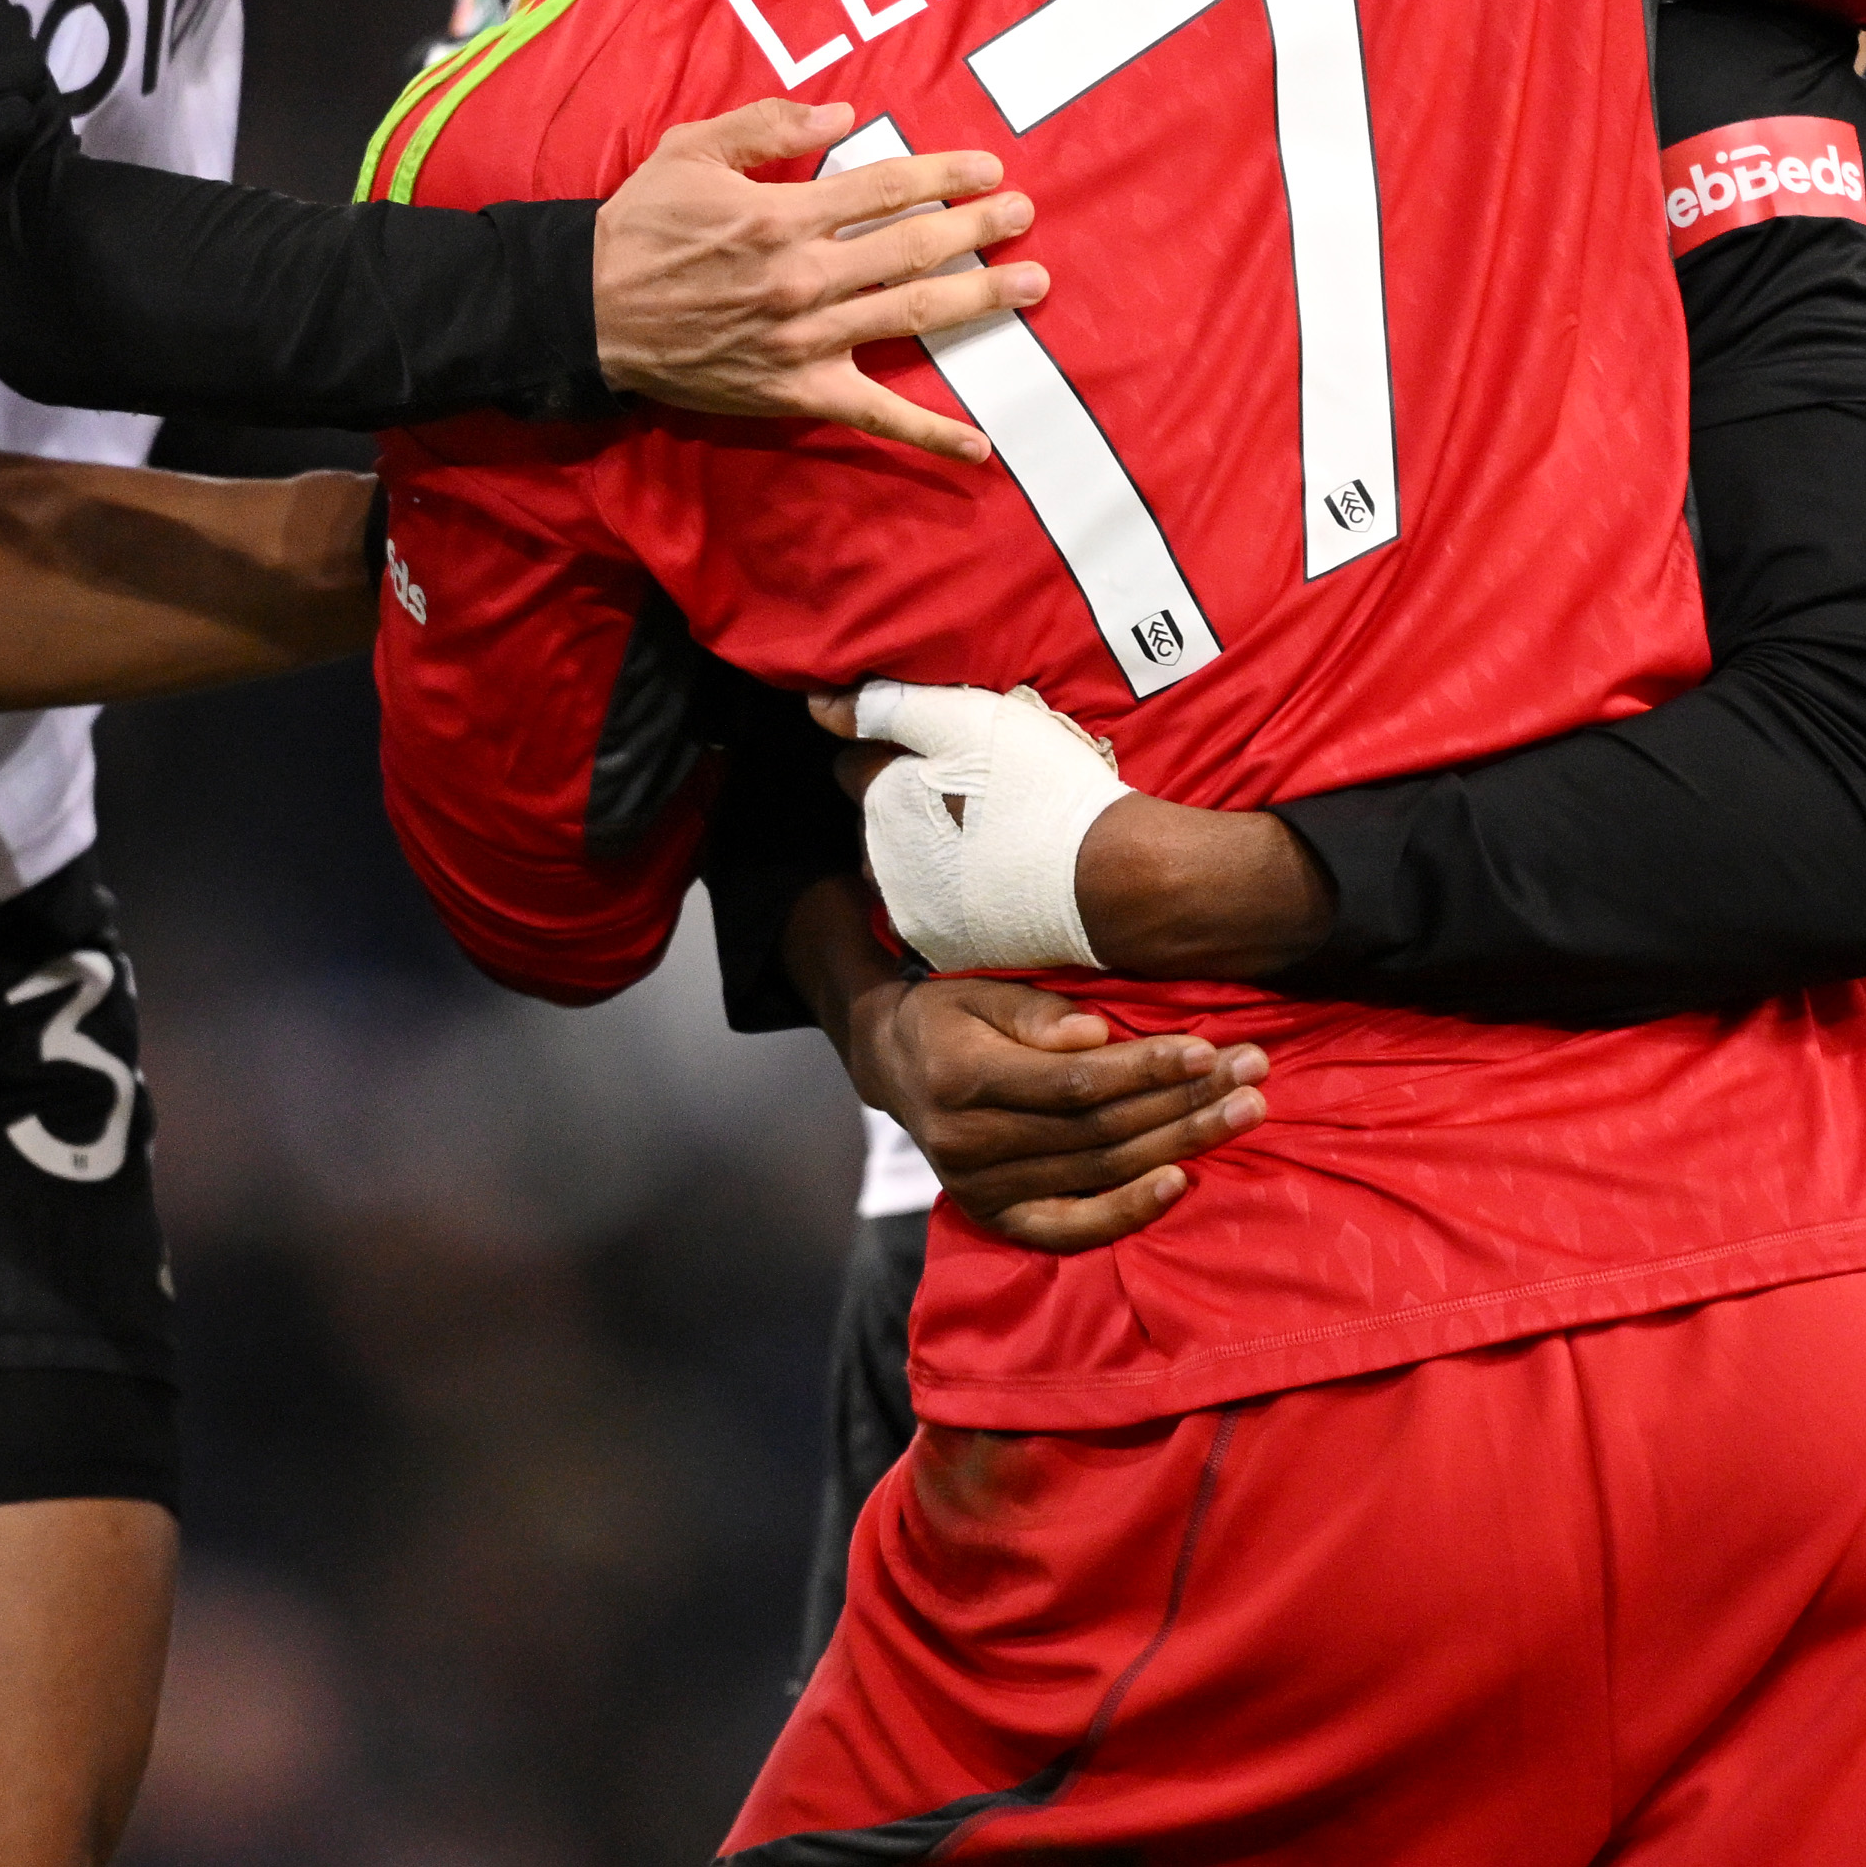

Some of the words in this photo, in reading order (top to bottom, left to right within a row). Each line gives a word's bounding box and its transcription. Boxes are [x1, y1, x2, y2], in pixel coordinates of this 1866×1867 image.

[1667, 144, 1863, 228] ebBeds
[1339, 490, 1366, 524] FFC
[1147, 621, 1174, 658] FFC
[4, 949, 141, 1185] 3
